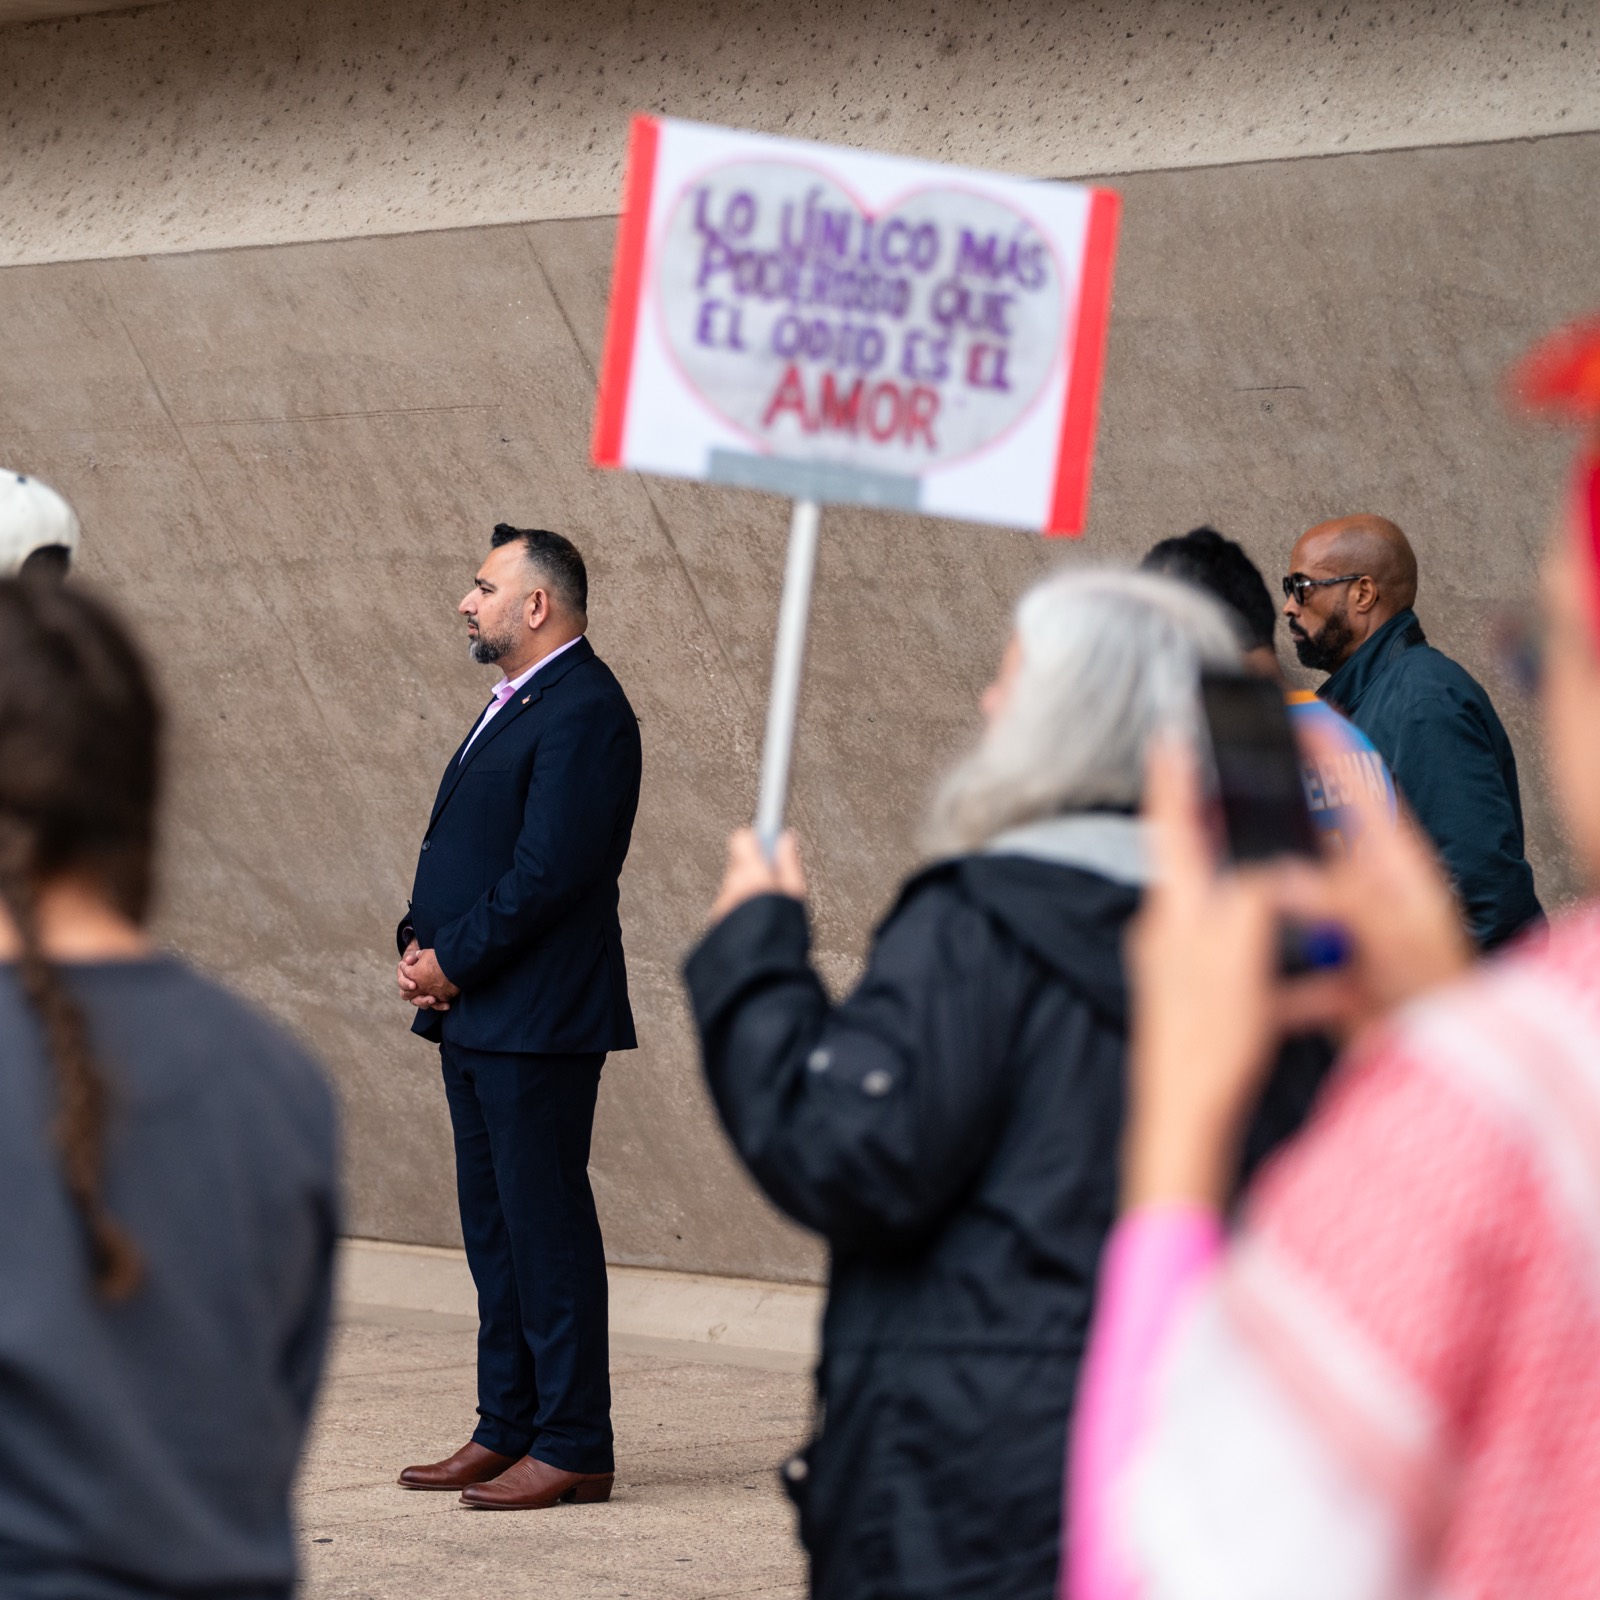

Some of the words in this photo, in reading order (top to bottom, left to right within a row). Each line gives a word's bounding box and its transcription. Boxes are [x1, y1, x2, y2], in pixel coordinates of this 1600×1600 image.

[694, 185, 757, 241] LO
[780, 183, 940, 274] ÚNICO
[956, 219, 1048, 290] MÁS
[696, 297, 745, 353] EL
[770, 312, 886, 374] ODIO
[901, 326, 952, 386] ES
[963, 340, 1012, 393] EL
[930, 279, 1016, 341] QUE
[761, 363, 940, 451] AMOR
